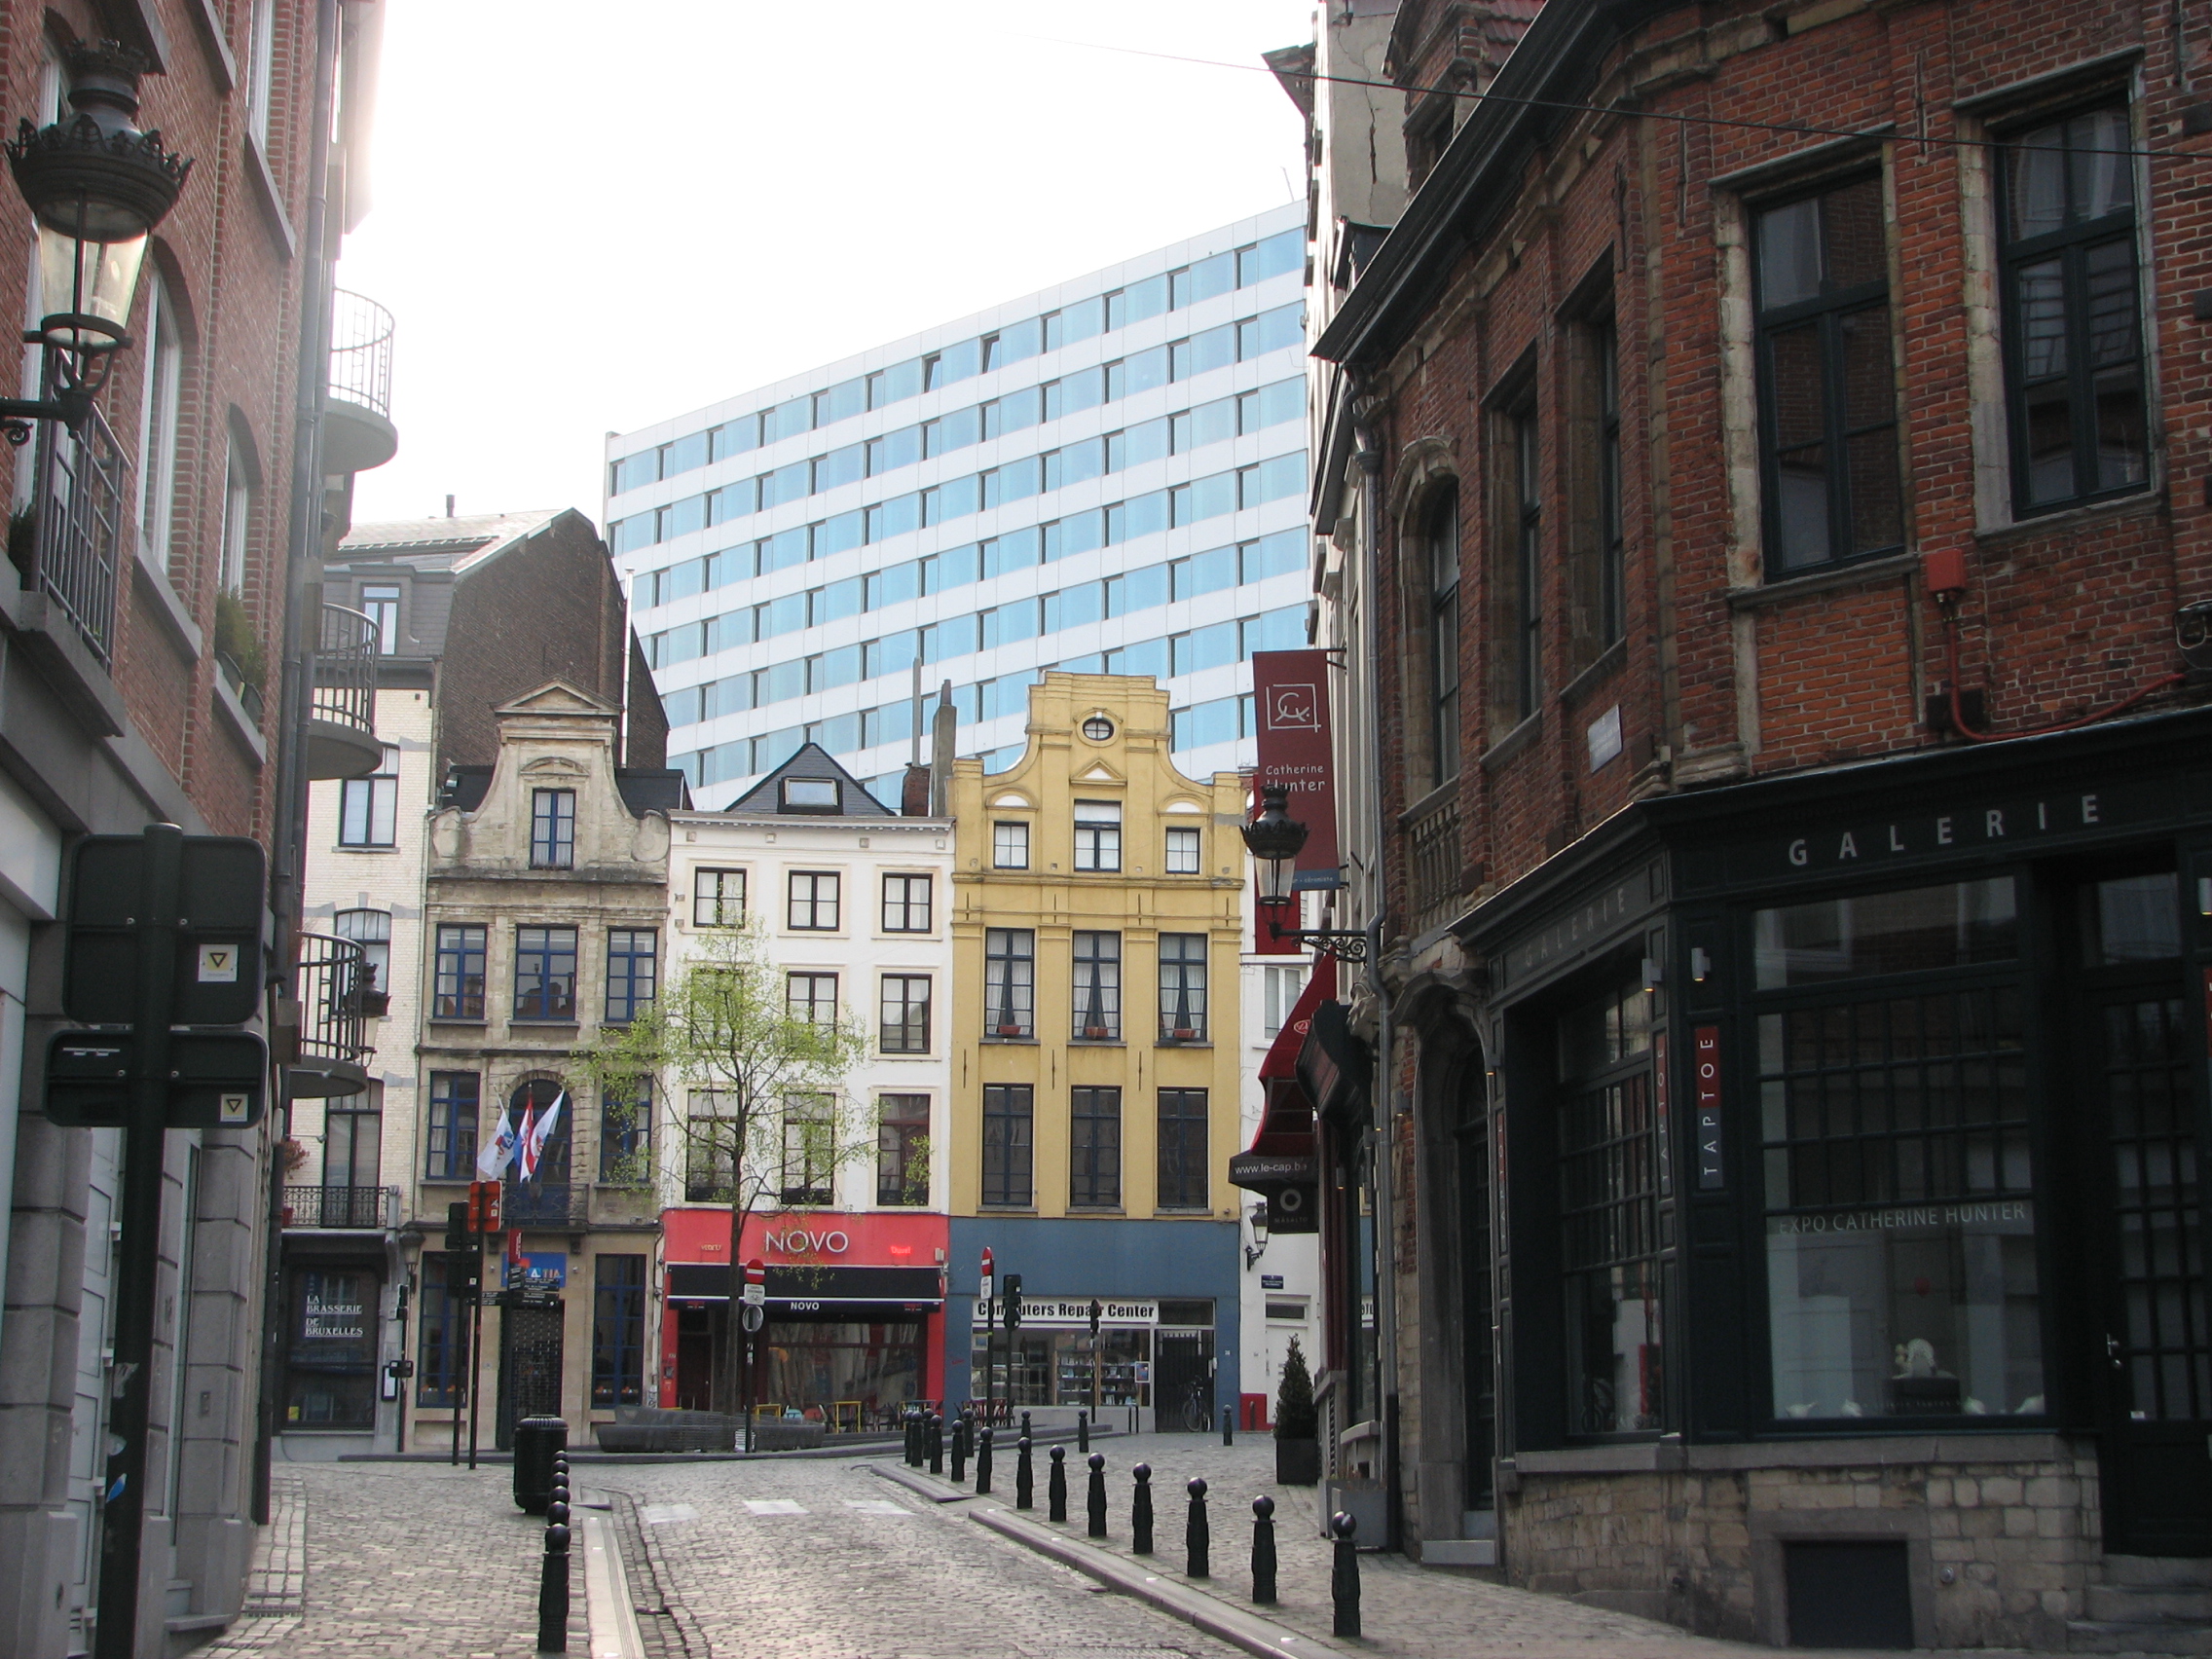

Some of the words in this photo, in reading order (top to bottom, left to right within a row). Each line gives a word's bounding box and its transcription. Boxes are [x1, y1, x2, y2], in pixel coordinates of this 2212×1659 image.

[1266, 764, 1324, 775] Catherine
[1788, 794, 2099, 866] GALERIE
[1526, 887, 1624, 968] GALERIE
[1657, 1050, 1669, 1182] TAPTOE
[1700, 1039, 1717, 1175] TAPTOE
[1779, 1214, 1825, 1235] EXPO
[1833, 1208, 1937, 1231] CATHERINE
[1945, 1203, 2024, 1224] HUNTER
[765, 1230, 849, 1254] NOVO
[306, 1305, 362, 1313] BRASSERIE
[307, 1295, 320, 1304] LA
[790, 1302, 820, 1310] NOVO
[977, 1302, 1054, 1316] Cmuters
[1058, 1303, 1104, 1318] Repar
[1108, 1304, 1155, 1318] Center
[305, 1327, 364, 1336] BRUXELLES
